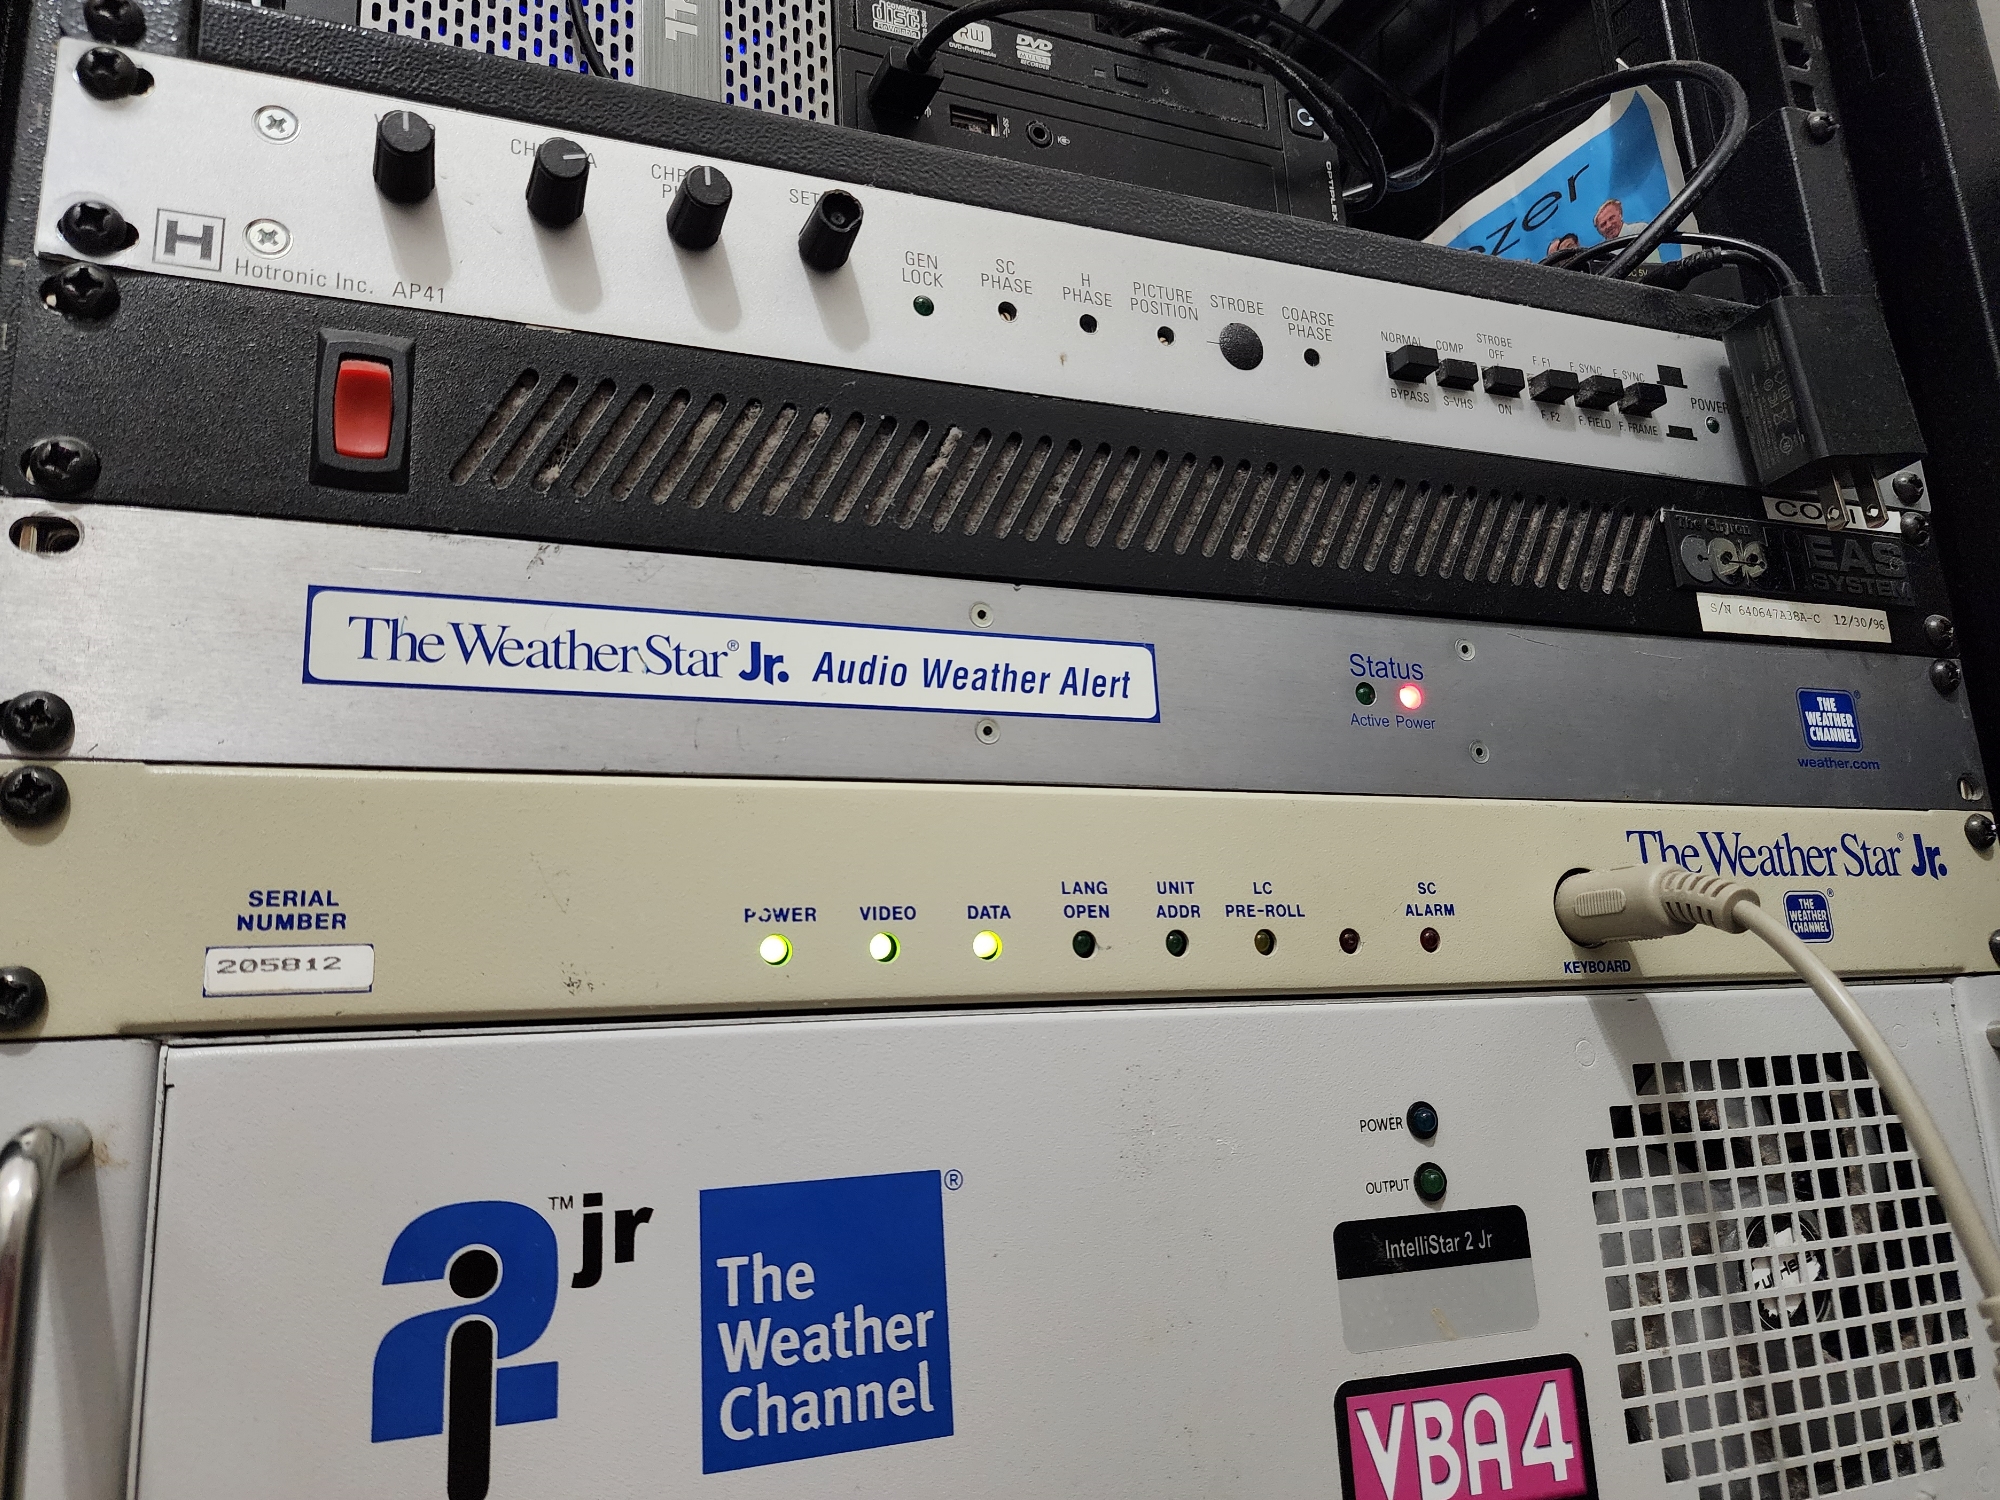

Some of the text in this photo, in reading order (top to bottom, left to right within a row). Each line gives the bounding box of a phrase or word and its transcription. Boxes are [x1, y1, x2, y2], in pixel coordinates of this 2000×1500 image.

[1016, 33, 1053, 51] DVD
[1326, 161, 1338, 222] OPTIPLEX
[1469, 163, 1590, 257] zer
[905, 250, 938, 269] GEN
[995, 258, 1016, 275] SC
[235, 257, 445, 304] Hotronic Inc. AP41
[902, 267, 944, 288] LOCK
[980, 273, 1033, 294] PHASE
[1081, 273, 1091, 287] H
[1062, 286, 1113, 307] PHASE
[1132, 281, 1194, 304] PICTURE
[1130, 298, 1199, 321] POSITION
[1209, 294, 1265, 316] STROBE
[1281, 306, 1335, 327] COARSE
[1287, 323, 1333, 342] PHASE
[1476, 333, 1513, 349] STROBE
[1435, 340, 1464, 353] COMP
[1488, 349, 1505, 360] OFF
[1579, 363, 1602, 375] SYNC
[1622, 370, 1645, 382] SYNC
[1390, 388, 1430, 403] BYPASS
[1443, 396, 1474, 410] S-VHS
[1498, 404, 1513, 415] ON
[1690, 397, 1729, 414] POWER
[1588, 417, 1612, 429] FIELD
[1628, 423, 1659, 436] FRAME
[1805, 535, 1907, 578] EAS
[1811, 572, 1914, 605] SYSTEM
[1710, 602, 1732, 615] S/N
[1834, 614, 1886, 630] 12/30/96
[348, 614, 447, 664] The
[738, 641, 789, 686] Jr.
[812, 651, 908, 688] Audio
[923, 657, 1051, 695] Weather
[1059, 666, 1131, 700] Alert
[1349, 653, 1424, 681] Status
[1816, 697, 1838, 712] THE
[1350, 712, 1436, 730] Active Power
[1805, 711, 1854, 728] WEATHER
[1810, 727, 1857, 743] CHANNEL
[1797, 757, 1881, 770] weather.com
[1626, 830, 1703, 873] The
[1911, 833, 1948, 881] Jr.
[1061, 881, 1108, 895] LANG
[1156, 881, 1195, 895] UNIT
[1253, 881, 1273, 895] LC
[1417, 881, 1437, 895] SC
[248, 890, 340, 908] SERIAL
[1798, 898, 1815, 910] THE
[744, 907, 817, 923] POWER
[859, 906, 917, 921] VIDEO
[967, 905, 1011, 920] DATA
[1063, 904, 1110, 918] OPEN
[1156, 904, 1201, 918] ADDR
[1225, 904, 1306, 918] PRE-ROLL
[1405, 903, 1455, 917] ALARM
[1789, 910, 1828, 921] WEATHER
[236, 913, 347, 932] NUMBER
[1792, 921, 1829, 933] CHANNEL
[216, 956, 342, 974] 205812
[1563, 960, 1632, 974] KEYBOARD
[1359, 1116, 1404, 1133] POWER
[1365, 1178, 1410, 1195] OUTPUT
[571, 1192, 654, 1288] jr
[1385, 1229, 1493, 1259] IntelliStar 2 Jr
[717, 1252, 815, 1307] The
[718, 1304, 935, 1373] Weather
[719, 1360, 935, 1441] Channel
